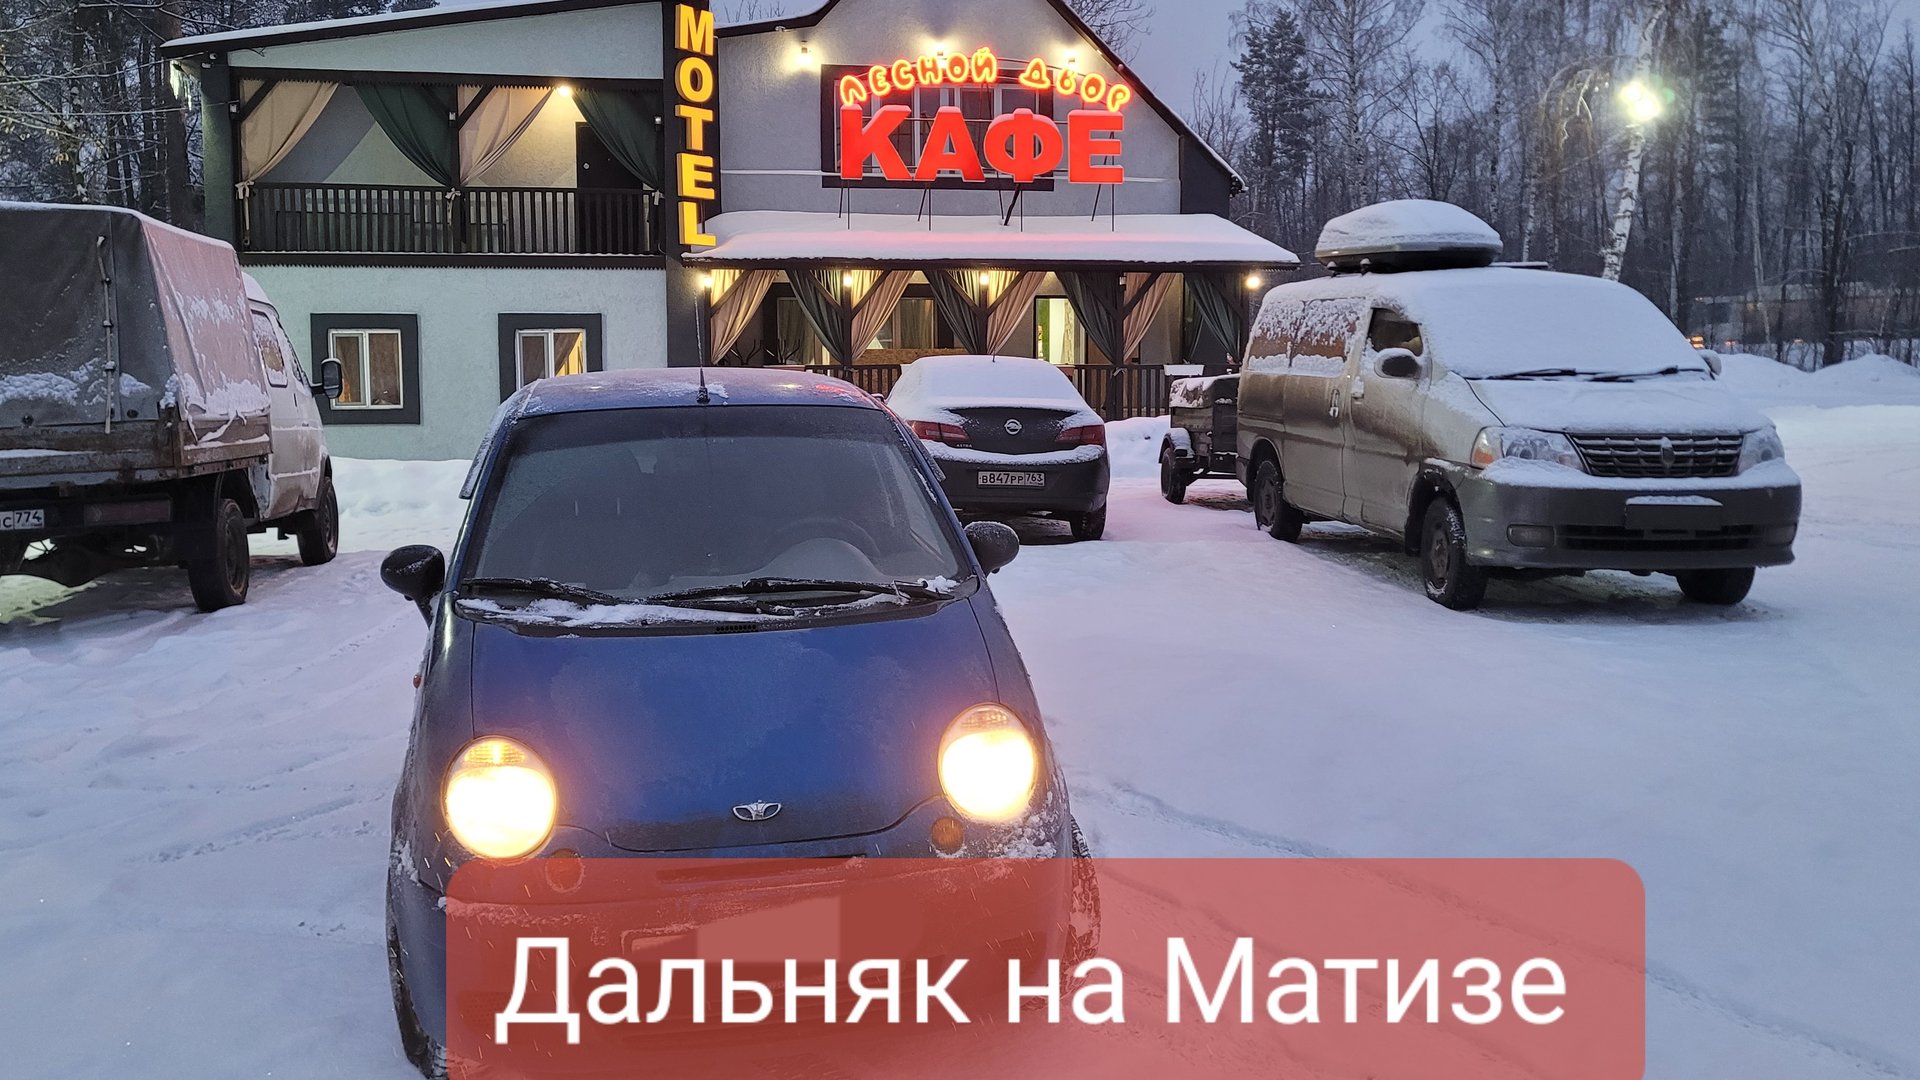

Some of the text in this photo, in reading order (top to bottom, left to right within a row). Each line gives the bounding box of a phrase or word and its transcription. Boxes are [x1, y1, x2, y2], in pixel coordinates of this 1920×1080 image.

[839, 46, 999, 106] ЛЕСНОЙ
[675, 3, 717, 247] MOTEL
[839, 103, 1125, 184] КАФЕ
